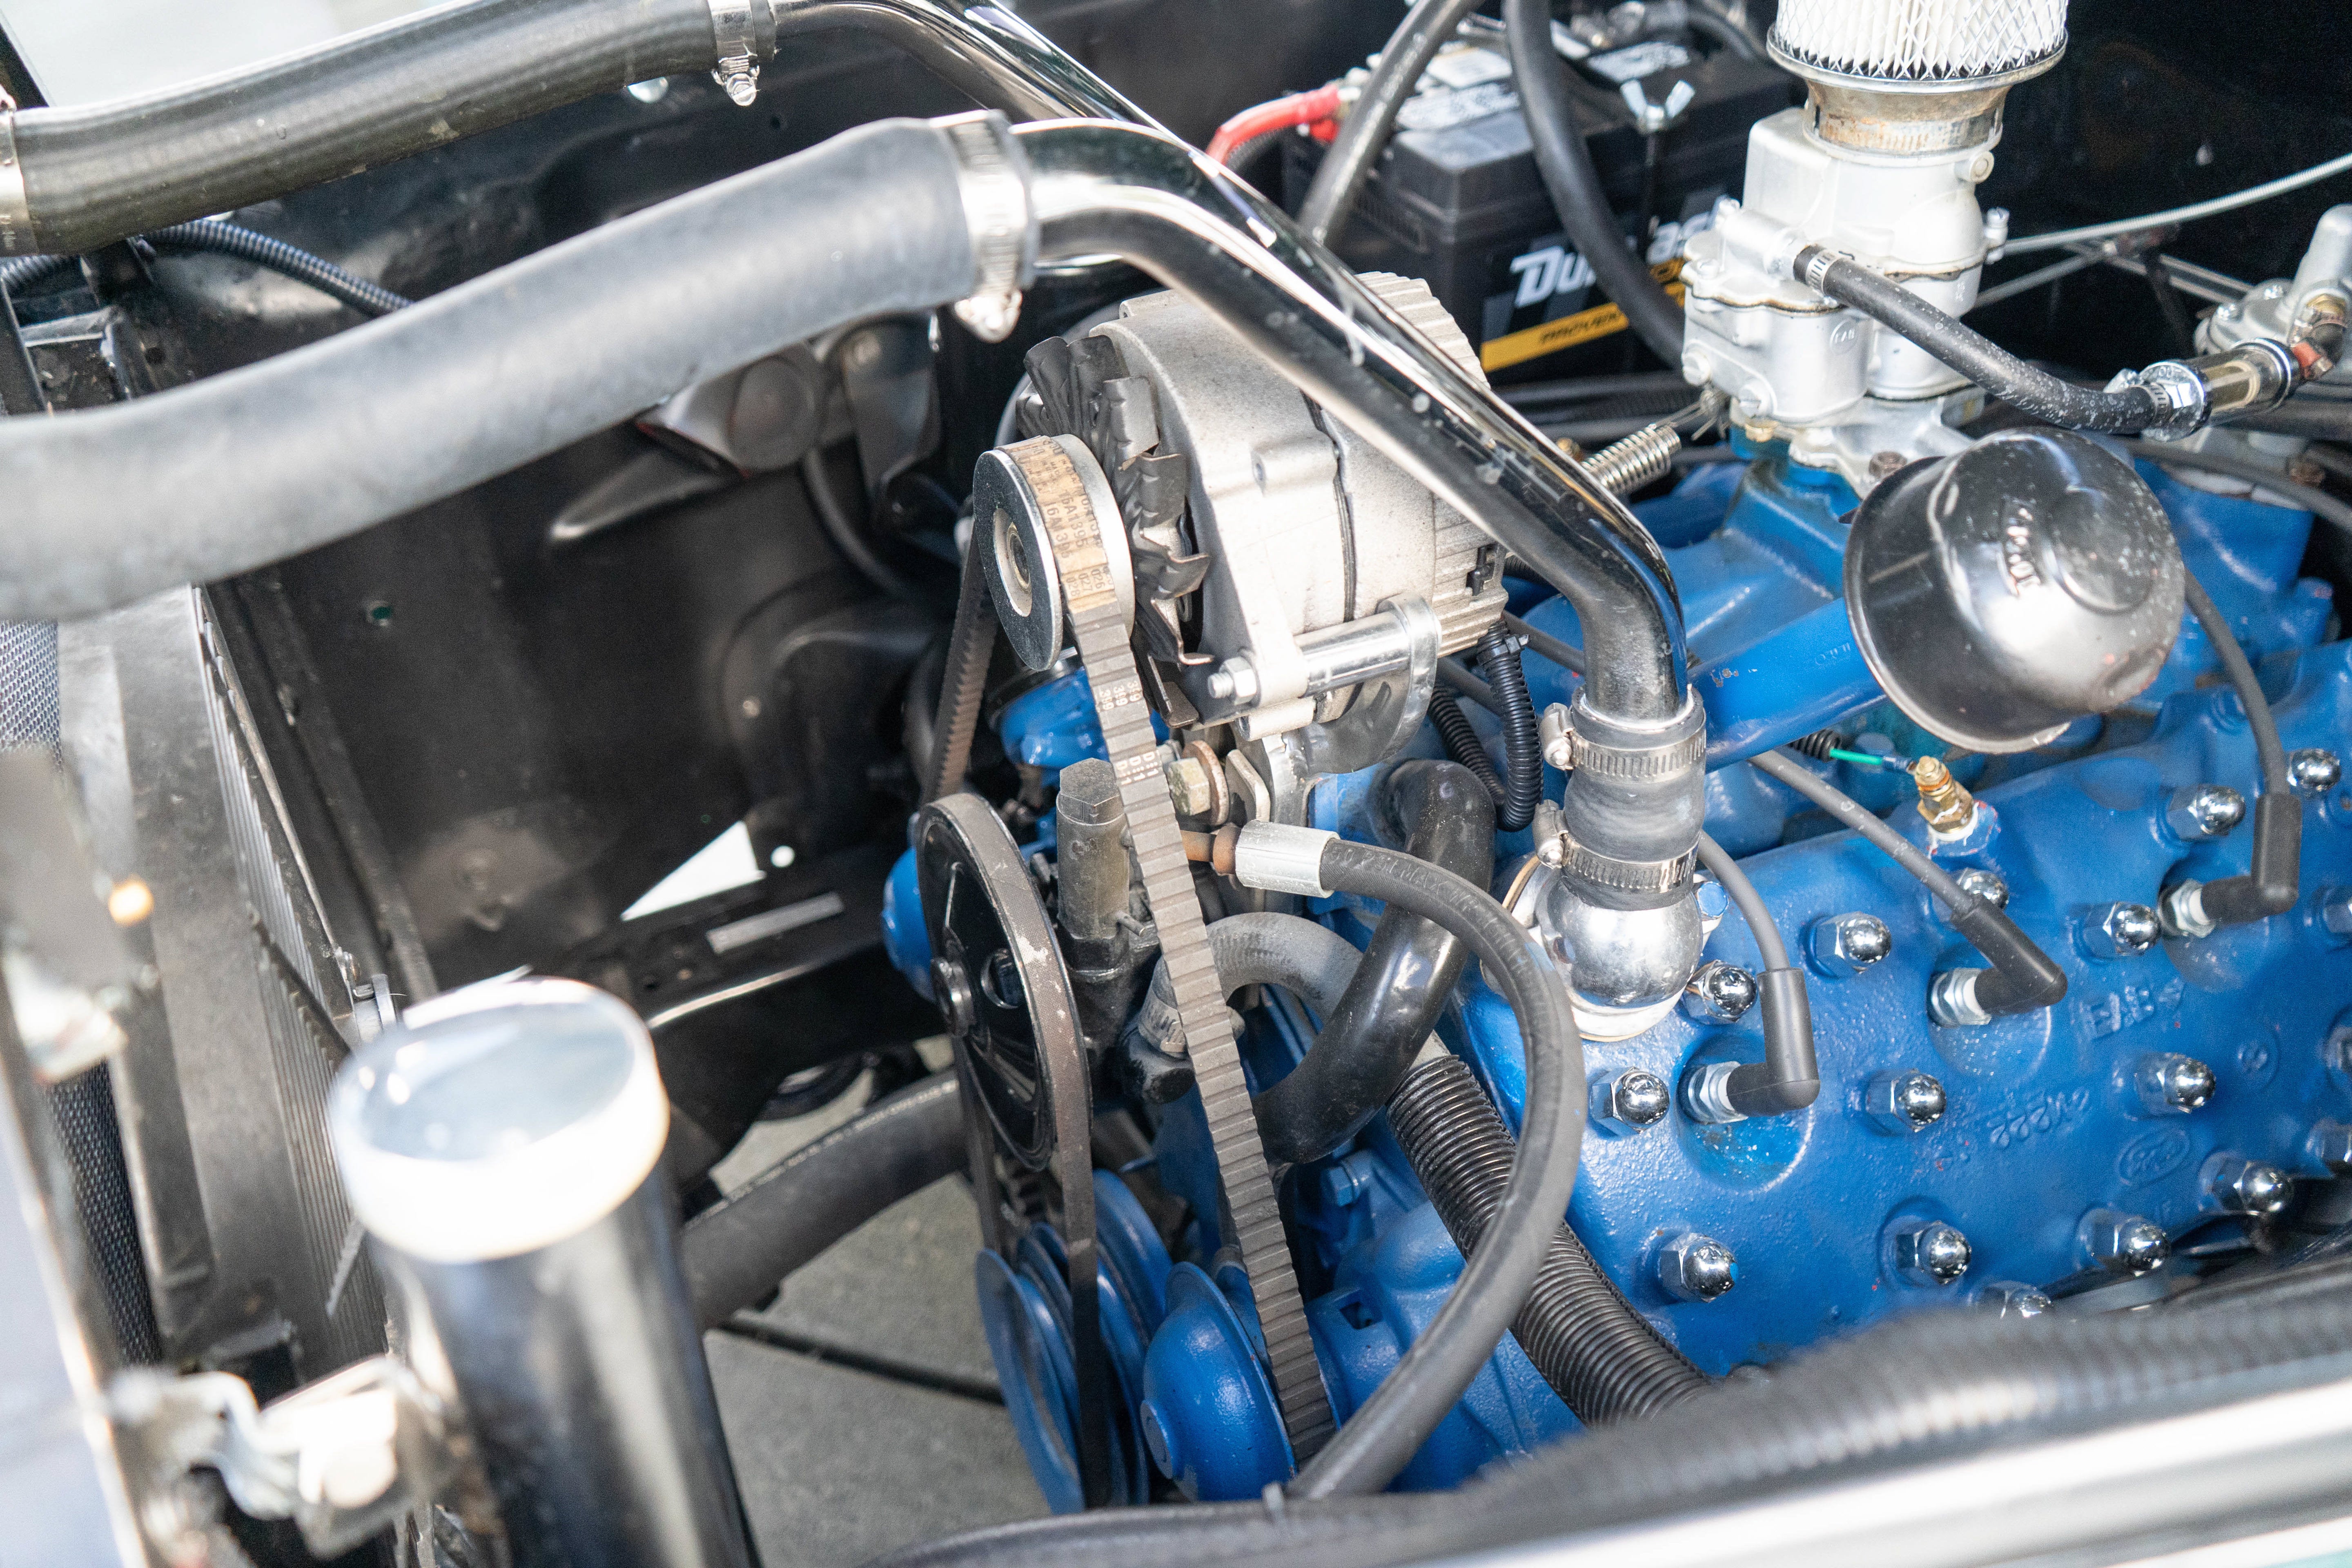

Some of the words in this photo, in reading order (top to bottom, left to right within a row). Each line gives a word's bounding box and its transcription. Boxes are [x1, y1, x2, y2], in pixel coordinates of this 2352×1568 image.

[1059, 490, 1088, 548] 16A1395
[1066, 577, 1080, 597] 028
[1078, 572, 1093, 592] 027
[1091, 568, 1105, 589] 026
[1361, 851, 1399, 874] PSI
[1401, 864, 1448, 895] MAX
